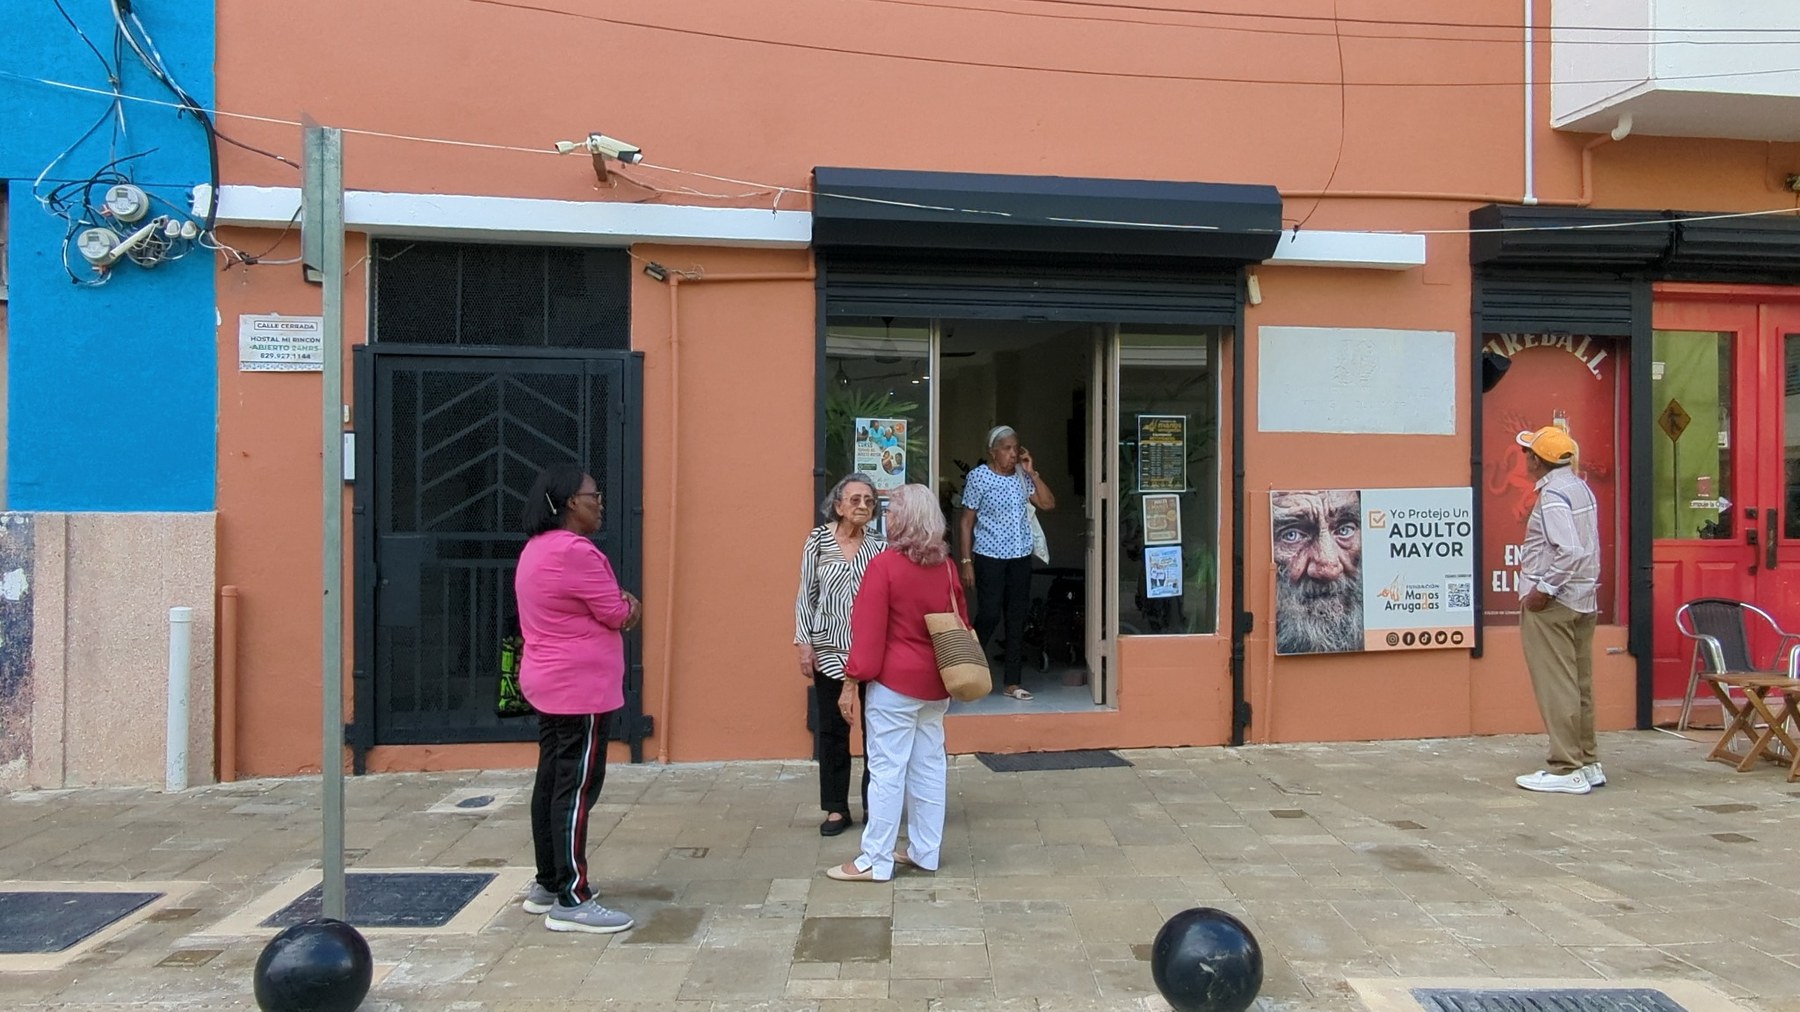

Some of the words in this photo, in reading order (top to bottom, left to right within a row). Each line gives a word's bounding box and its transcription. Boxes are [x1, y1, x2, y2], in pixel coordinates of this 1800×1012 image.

[1482, 333, 1608, 376] IREBALL
[1390, 510, 1405, 518] Yo
[1408, 508, 1450, 520] Protejo
[1453, 508, 1469, 518] Un
[1389, 522, 1471, 538] ADULTO
[1390, 542, 1464, 558] MAYOR
[1492, 570, 1511, 592] EL
[1405, 590, 1439, 600] Manos
[1385, 600, 1439, 613] Arrugadas
